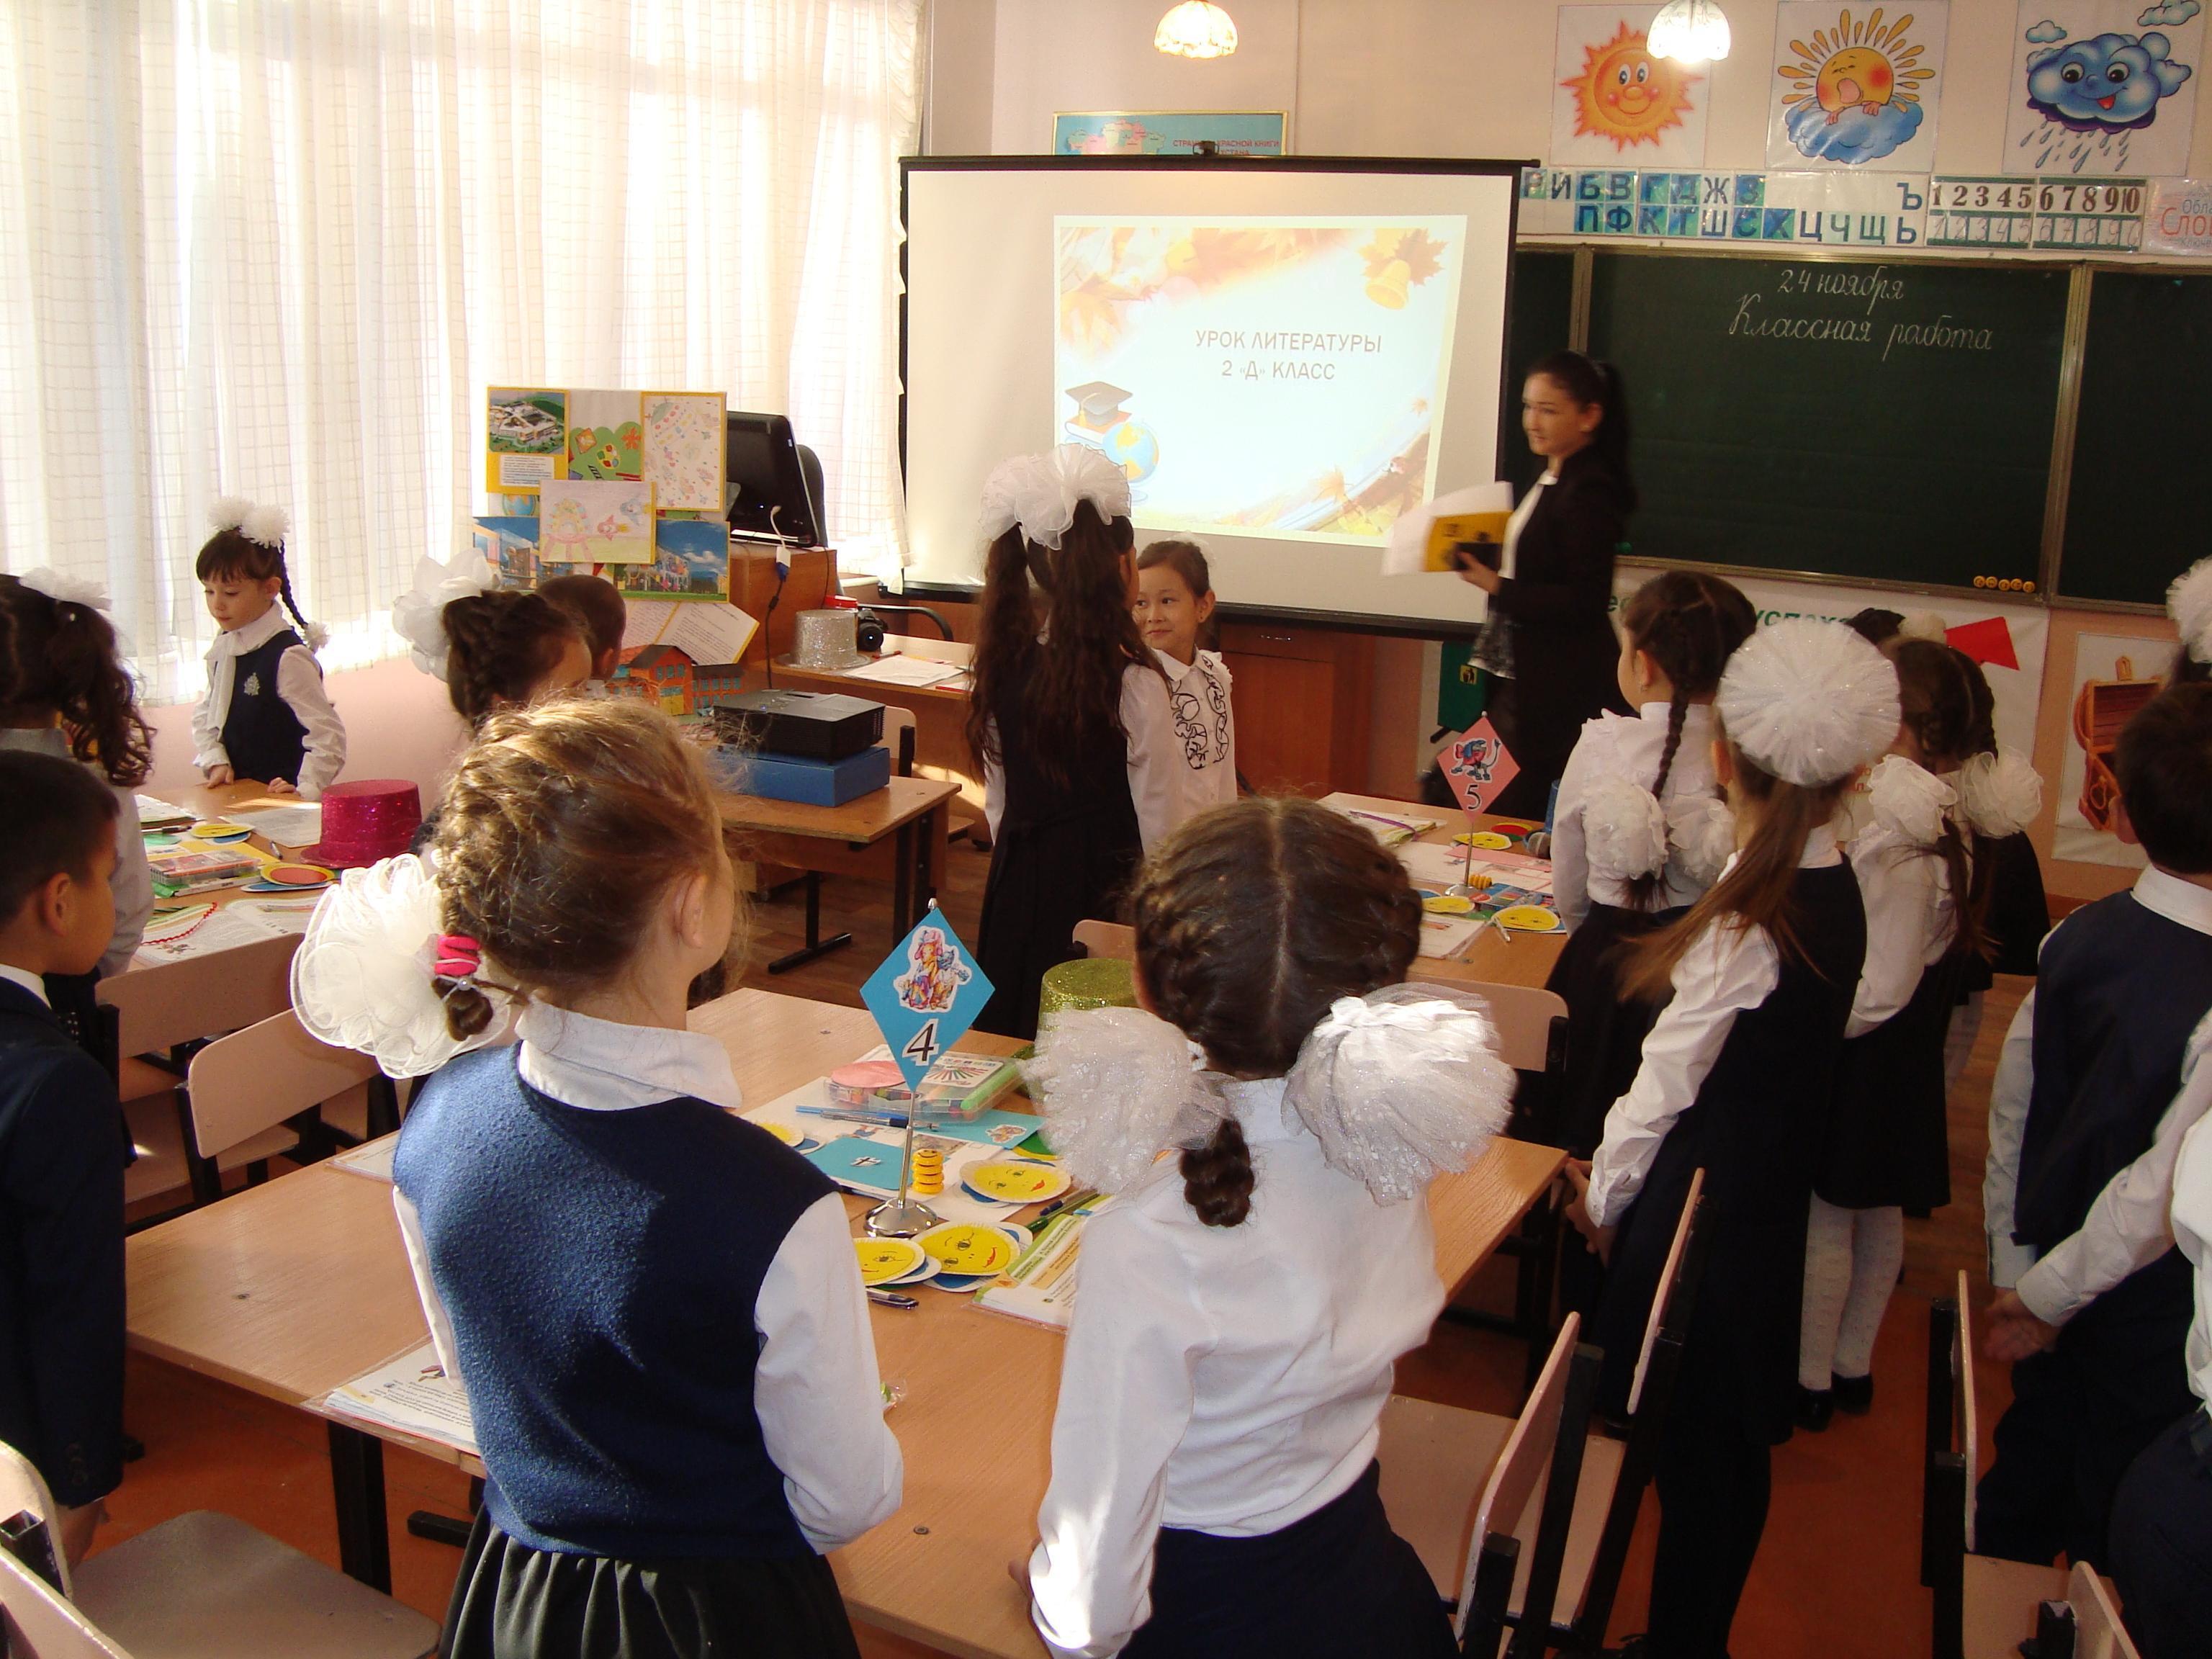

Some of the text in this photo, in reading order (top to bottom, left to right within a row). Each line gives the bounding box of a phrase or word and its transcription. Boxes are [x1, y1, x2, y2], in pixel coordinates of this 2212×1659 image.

[1581, 174, 1600, 199] Б
[1610, 174, 1630, 200] В
[1704, 177, 1730, 204] Ж
[1897, 182, 1923, 210] Ъ
[1933, 184, 2141, 214] 1 2 3 4 5 6 7 8 9 10
[1579, 206, 1917, 245] П Ф К Т Ш С Х Ц Ч Щ Ь
[1954, 216, 1966, 240] 2
[1974, 217, 1987, 241] 3
[1996, 217, 2009, 243] 4
[2017, 218, 2031, 243] 5
[2038, 219, 2052, 242] 6
[2064, 219, 2075, 243] 7
[2083, 218, 2098, 244] 8
[1778, 266, 1904, 315] 24 ноября
[1195, 330, 1382, 353] УРОК ЛИТЕРАТУРЫ
[1730, 294, 1993, 361] Классная работа
[1222, 360, 1335, 380] 2 «Д» КЛАСС
[1466, 784, 1482, 810] 5
[906, 1022, 935, 1062] 4
